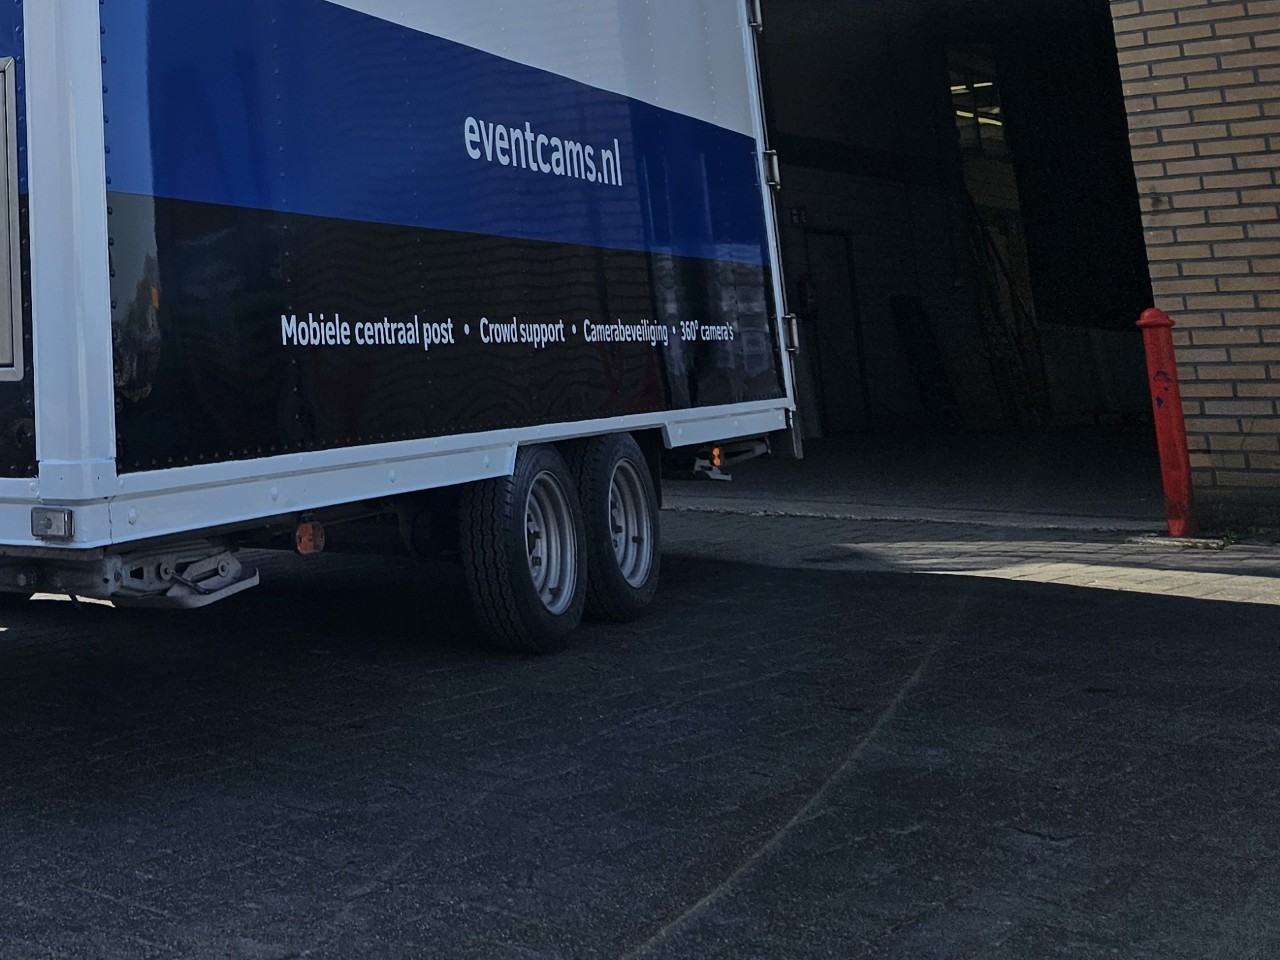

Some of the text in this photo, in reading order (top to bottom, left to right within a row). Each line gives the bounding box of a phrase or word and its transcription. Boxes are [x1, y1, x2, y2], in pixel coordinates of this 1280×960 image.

[464, 116, 623, 187] eventcams.nl
[281, 313, 351, 346] Mobiele
[354, 314, 420, 345] centraal
[423, 318, 455, 351] post
[479, 317, 518, 344] Crowd
[520, 319, 565, 349] support
[700, 321, 735, 342] camera's
